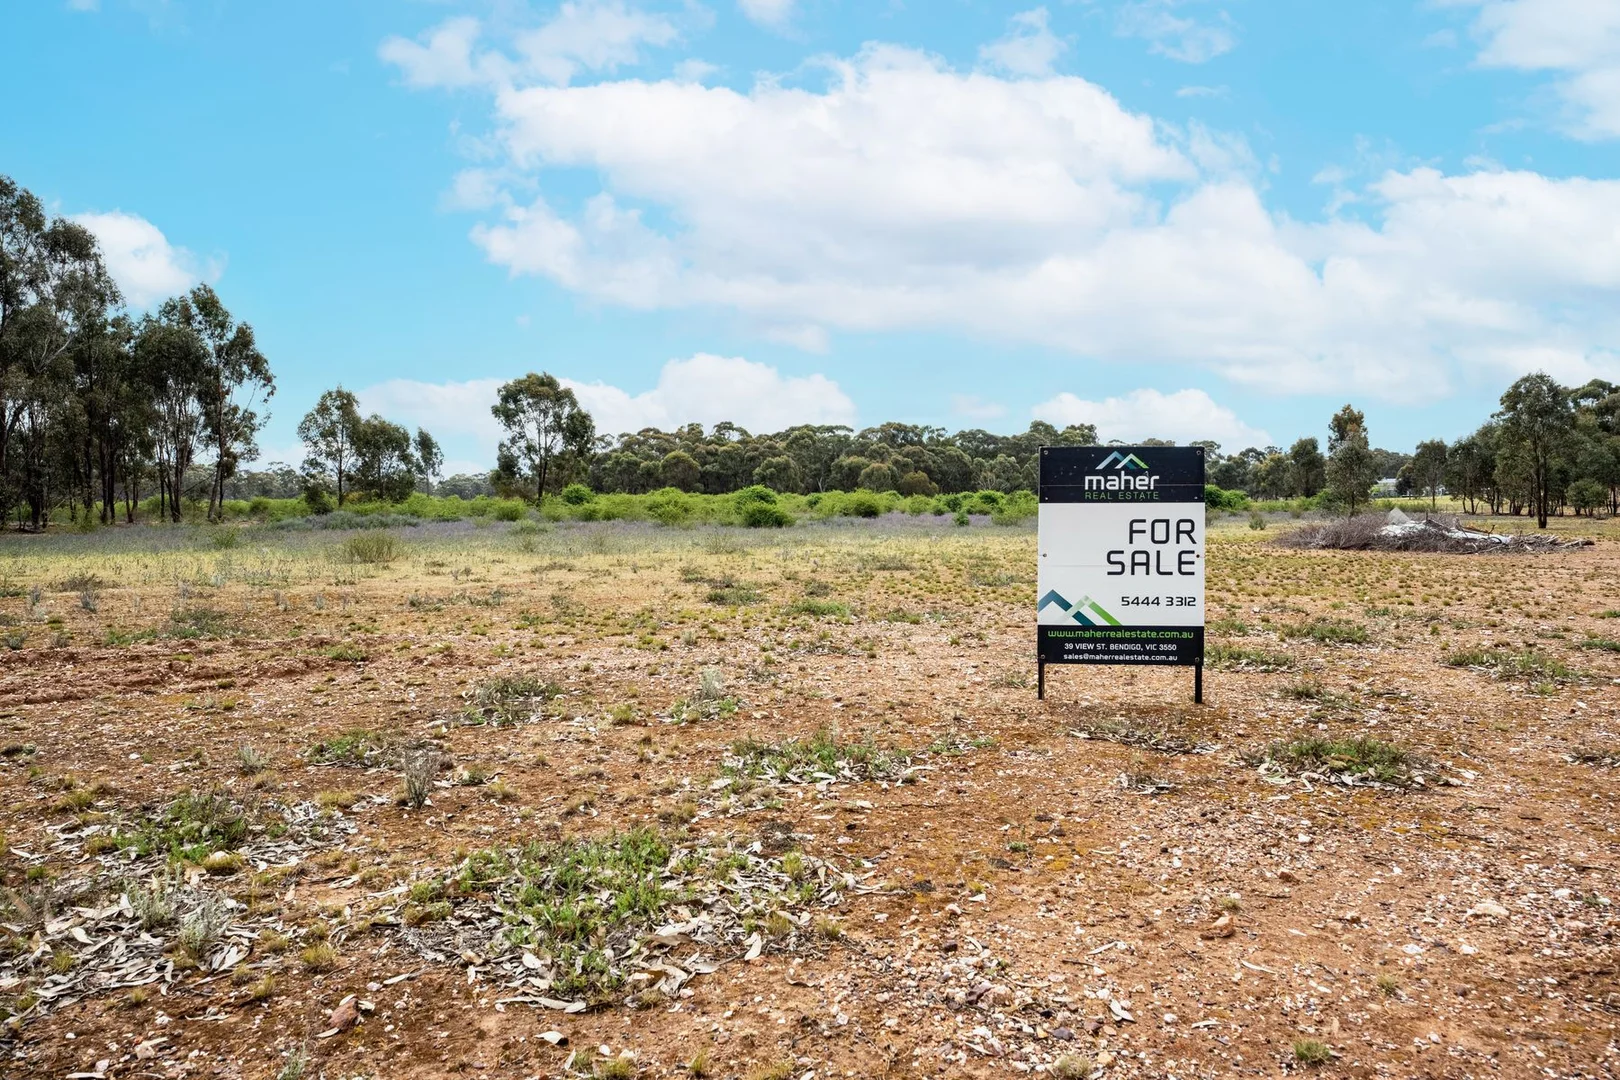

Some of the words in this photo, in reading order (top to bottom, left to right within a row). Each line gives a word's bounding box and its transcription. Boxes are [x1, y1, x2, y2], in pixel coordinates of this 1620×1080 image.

[1084, 470, 1160, 490] maher
[1085, 491, 1113, 500] REAL
[1118, 491, 1159, 500] ESTATE
[1129, 518, 1197, 545] FOR
[1106, 550, 1195, 576] SALE
[1121, 596, 1161, 607] 5444
[1165, 596, 1196, 607] 3312
[1047, 629, 1194, 639] www.maherrealestate.com.au
[1064, 642, 1074, 650] 39
[1075, 642, 1095, 650] VIEW
[1145, 643, 1158, 651] VIC
[1158, 643, 1177, 651] 3550
[1063, 653, 1178, 661] sales@maherrealestate.com.au
